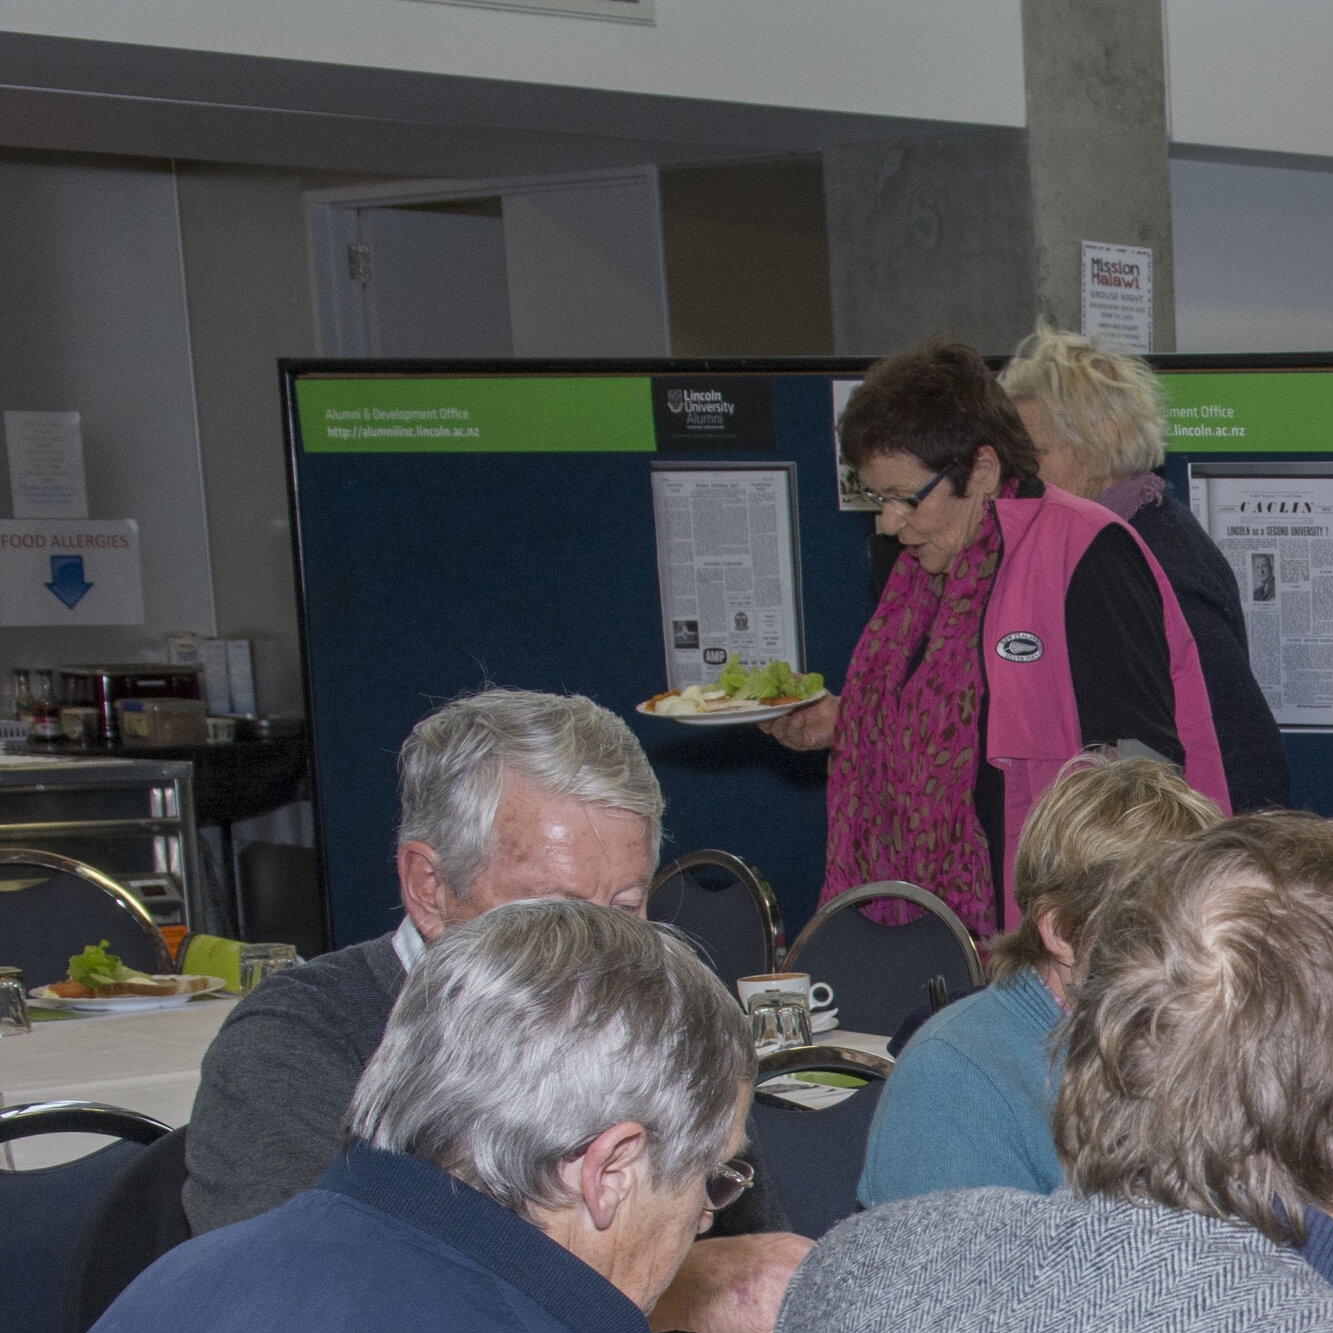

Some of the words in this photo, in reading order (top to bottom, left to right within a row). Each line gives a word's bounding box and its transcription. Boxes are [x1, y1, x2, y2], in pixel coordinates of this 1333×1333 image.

[1091, 272, 1140, 290] Malawi
[683, 389, 722, 401] Lincoln
[326, 408, 361, 420] Alumni
[363, 408, 371, 420] &
[373, 408, 437, 421] Development
[439, 407, 470, 419] Office
[684, 400, 734, 415] University
[1200, 405, 1235, 418] Office
[686, 412, 723, 424] Alumni
[1240, 501, 1314, 513] CACLIN
[1227, 526, 1250, 536] LINCOLN
[1266, 526, 1288, 536] SECOND
[1291, 526, 1323, 537] UNIVERSITY
[1, 534, 45, 548] FOOD
[50, 534, 129, 548] ALLERGIES
